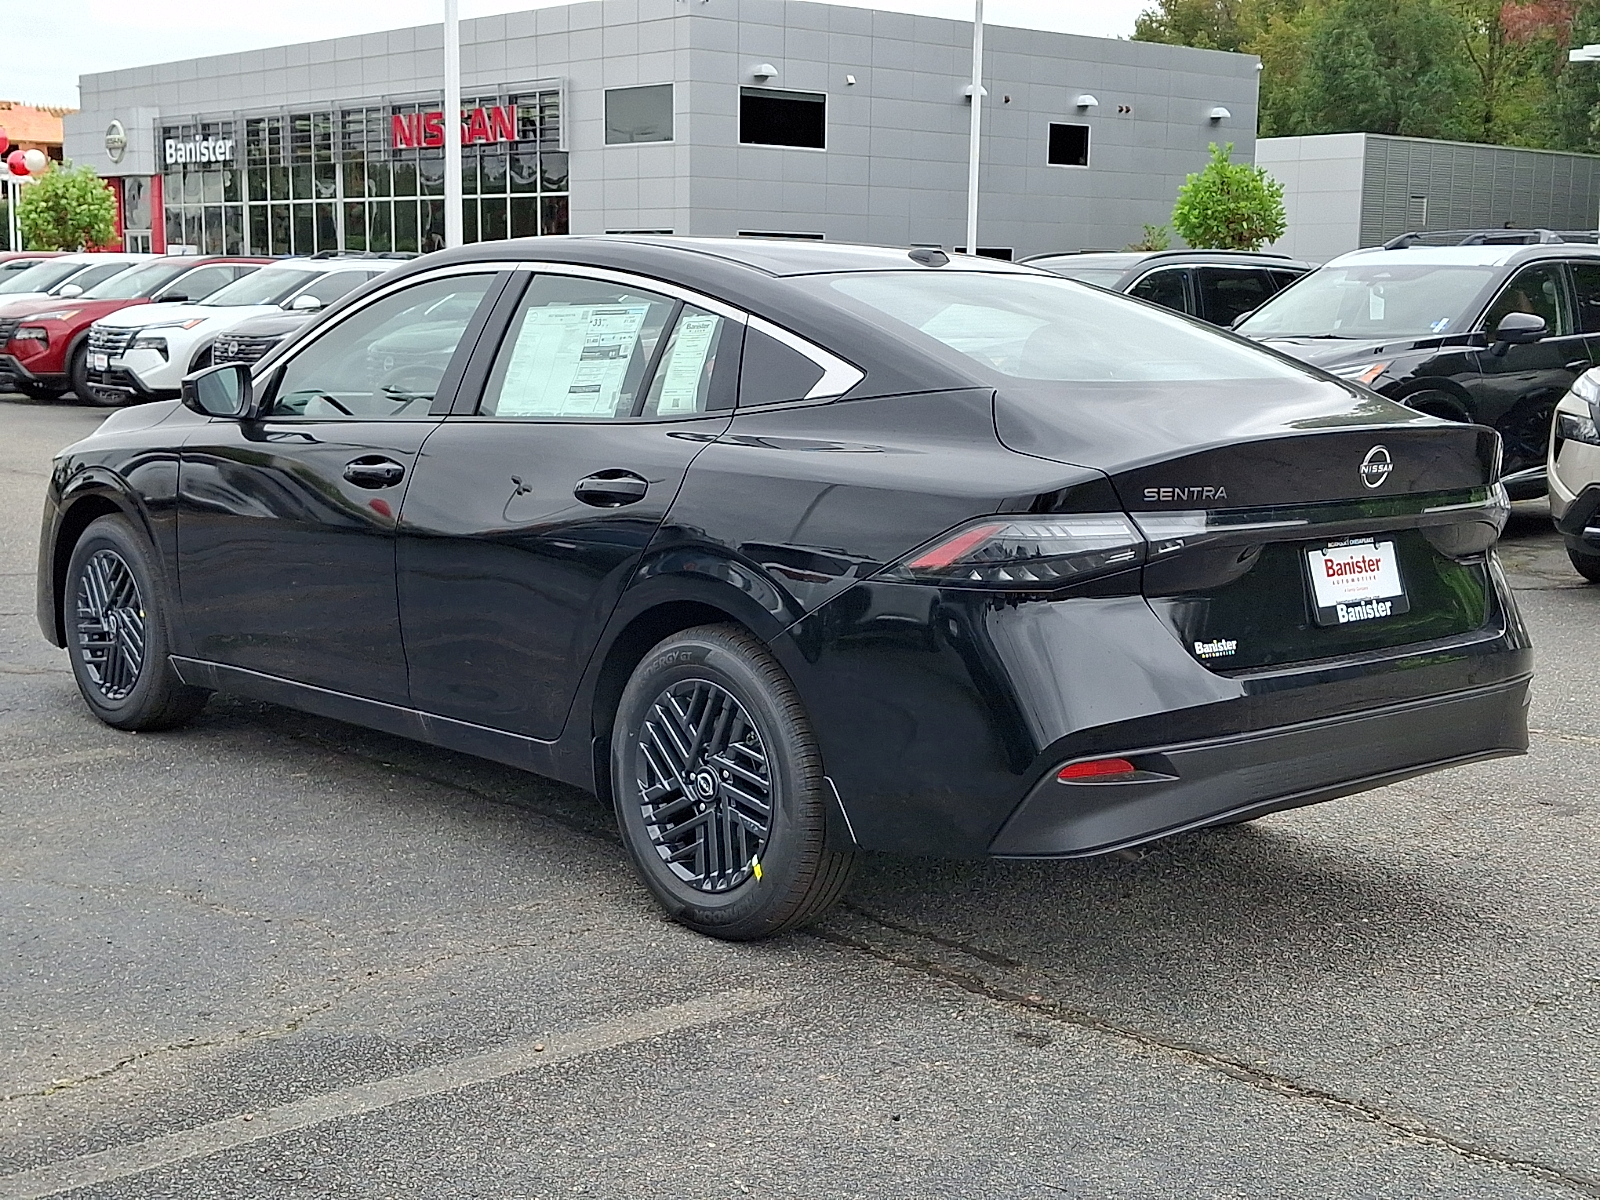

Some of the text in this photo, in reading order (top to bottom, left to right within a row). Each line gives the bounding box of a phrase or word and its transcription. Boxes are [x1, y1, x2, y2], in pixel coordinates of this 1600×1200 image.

[165, 134, 233, 164] Banister
[1360, 463, 1393, 474] NISSAN
[1143, 486, 1228, 501] SENTRA
[1323, 555, 1381, 578] Banister
[1332, 574, 1377, 586] AUTOMOTIVE
[1336, 599, 1392, 623] Banister
[1194, 639, 1237, 654] Banister
